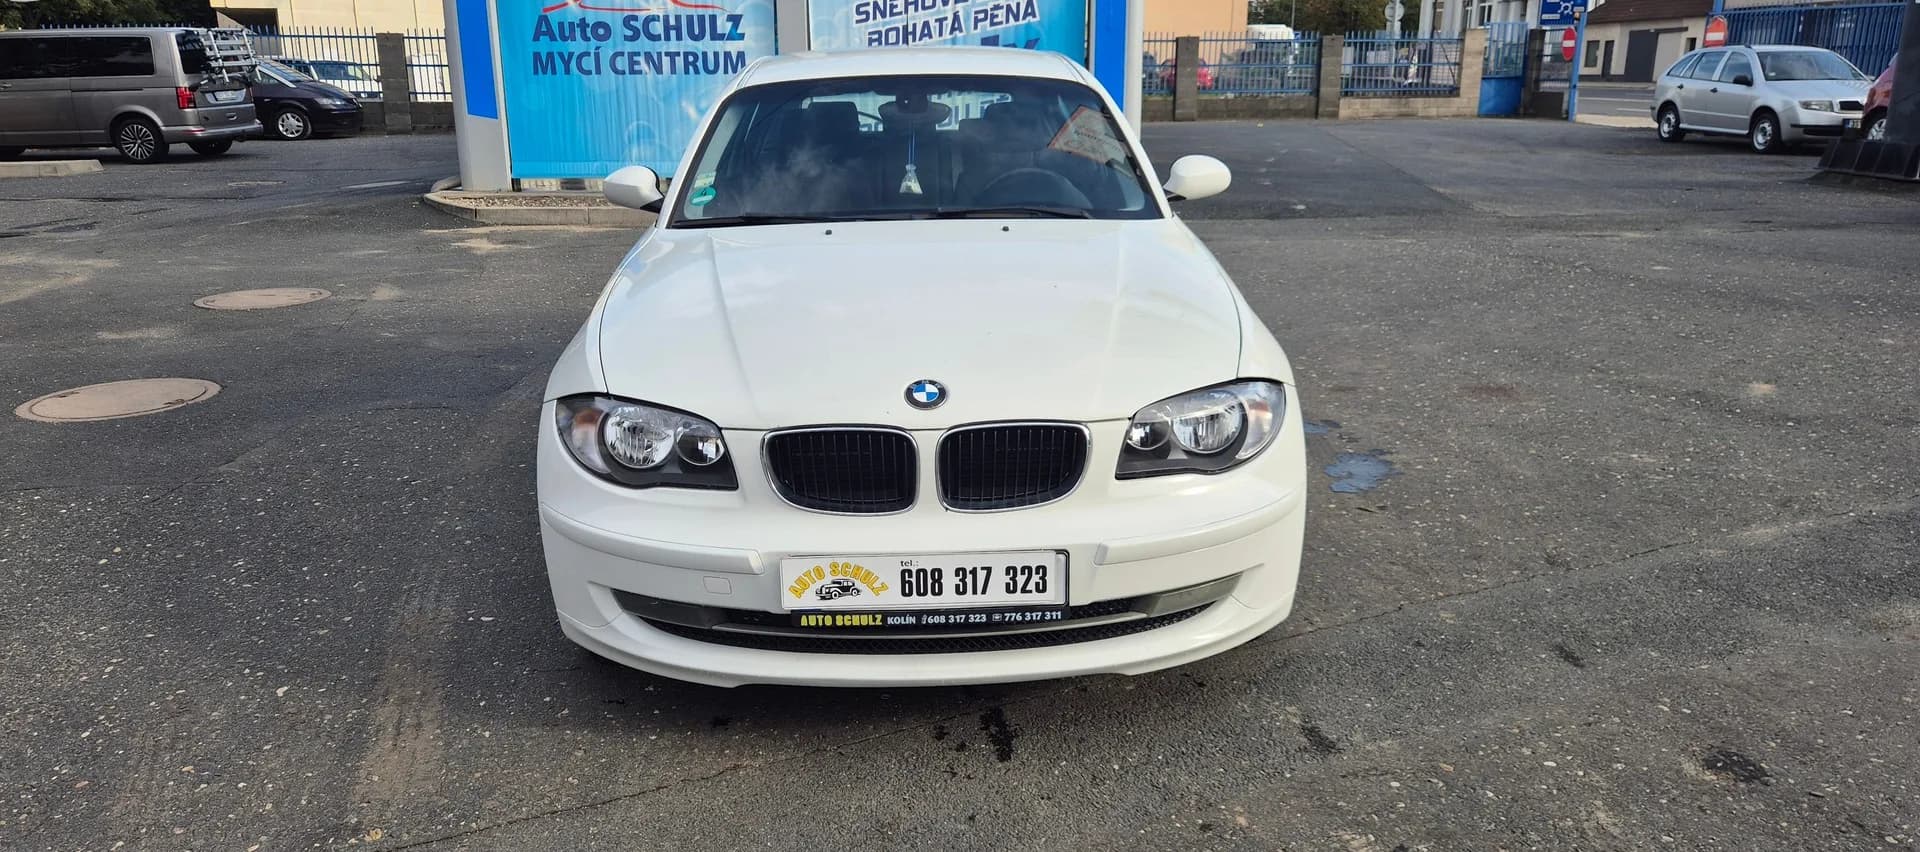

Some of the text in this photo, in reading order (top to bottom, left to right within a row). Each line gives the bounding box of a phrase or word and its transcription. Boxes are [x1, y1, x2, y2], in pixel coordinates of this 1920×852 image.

[532, 14, 745, 42] Auto SCHULZ
[532, 46, 746, 76] MYCÍ CENTRUM
[788, 561, 889, 599] AUTO SCHULZ
[900, 565, 1048, 597] 608 317 323
[800, 611, 1061, 626] AUTO SCHULZ KOLÍN 608 317 323 776 317 311
